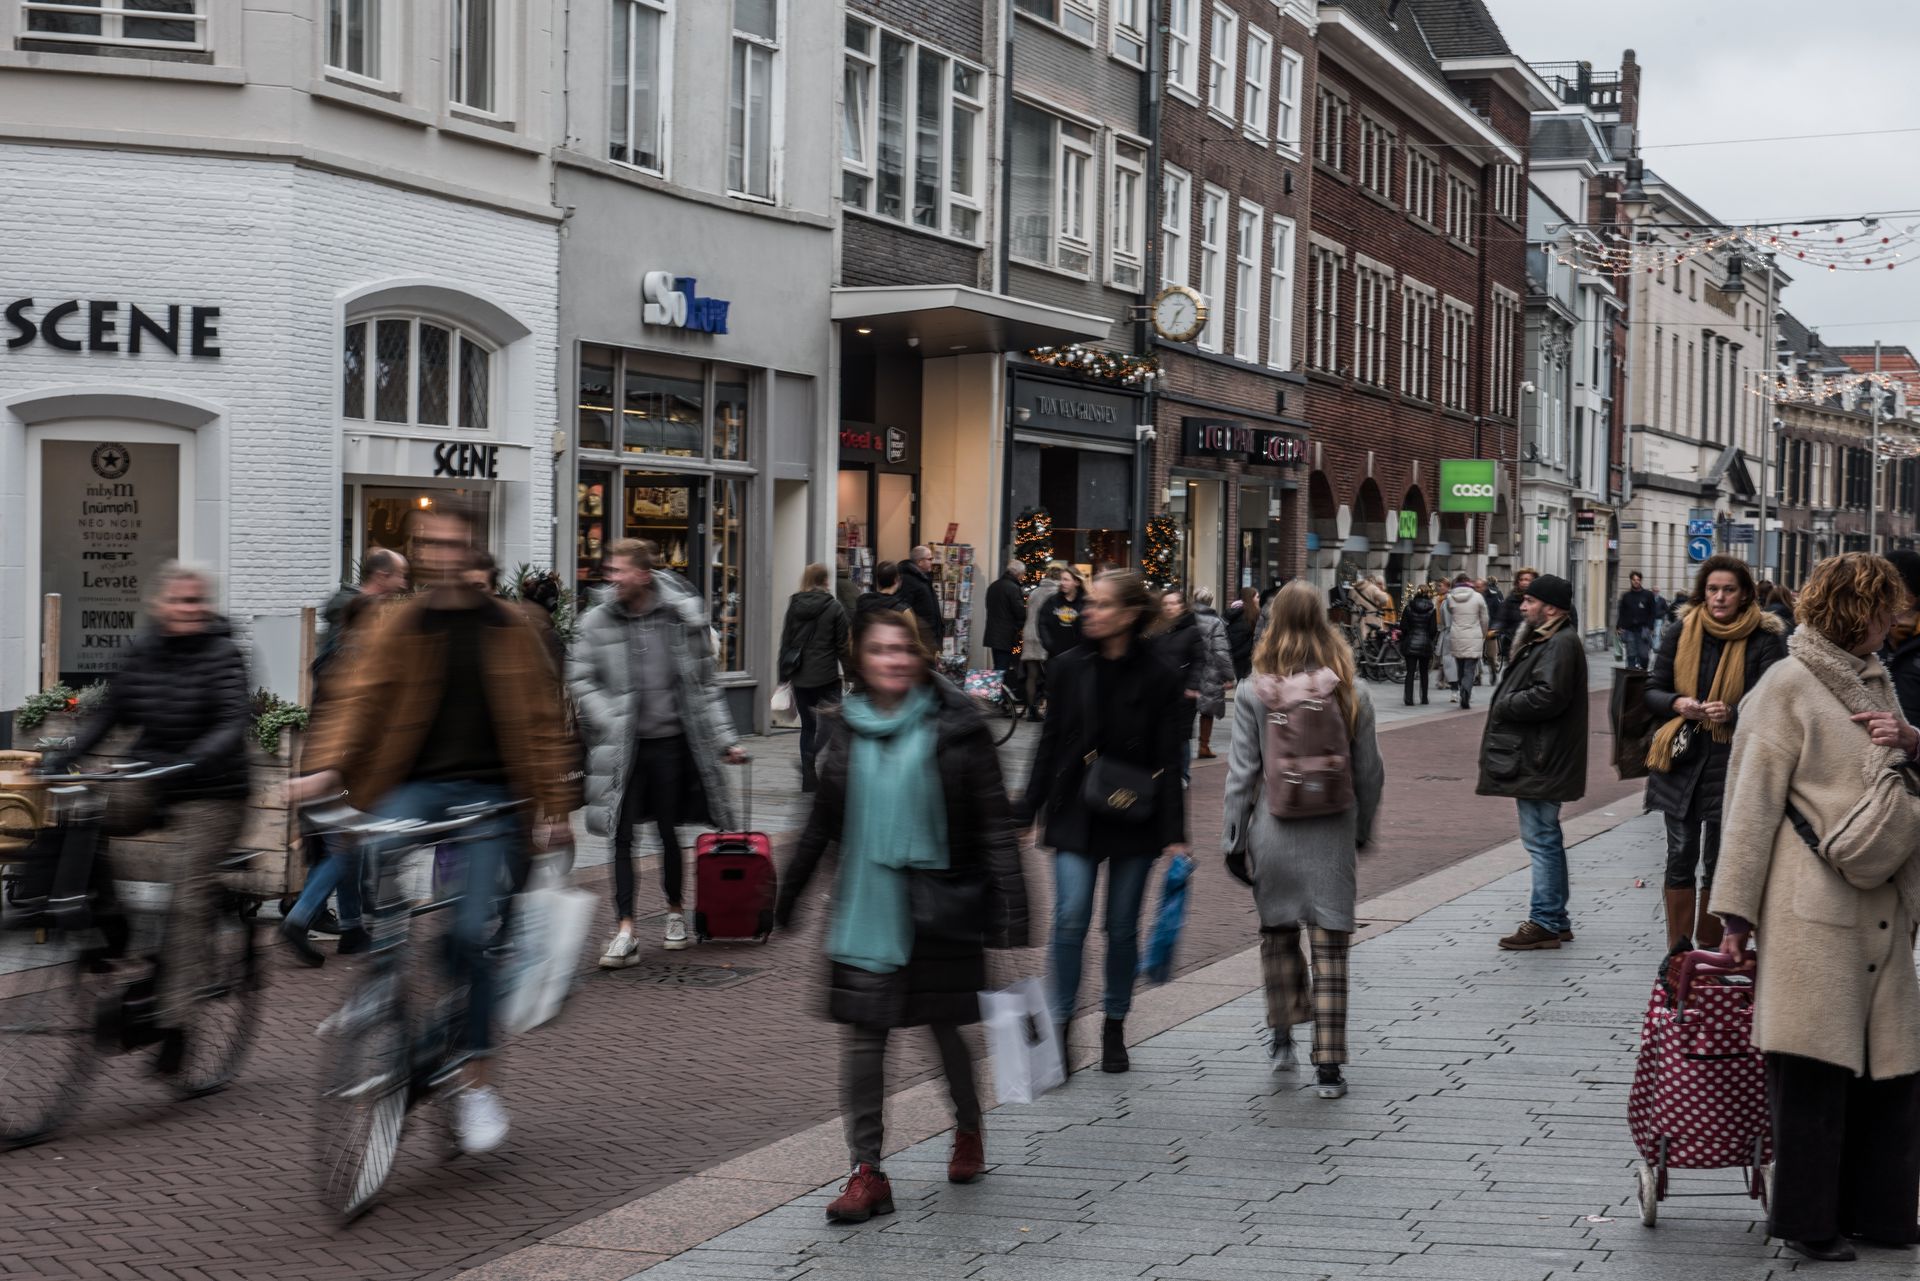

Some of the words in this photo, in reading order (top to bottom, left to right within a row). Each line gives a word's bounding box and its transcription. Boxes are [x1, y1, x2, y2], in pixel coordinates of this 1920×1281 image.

[4, 297, 221, 358] SCENE
[433, 441, 499, 479] SCENE
[1452, 483, 1495, 497] casa
[82, 610, 136, 630] DRYKORN
[81, 634, 121, 649] JOSH
